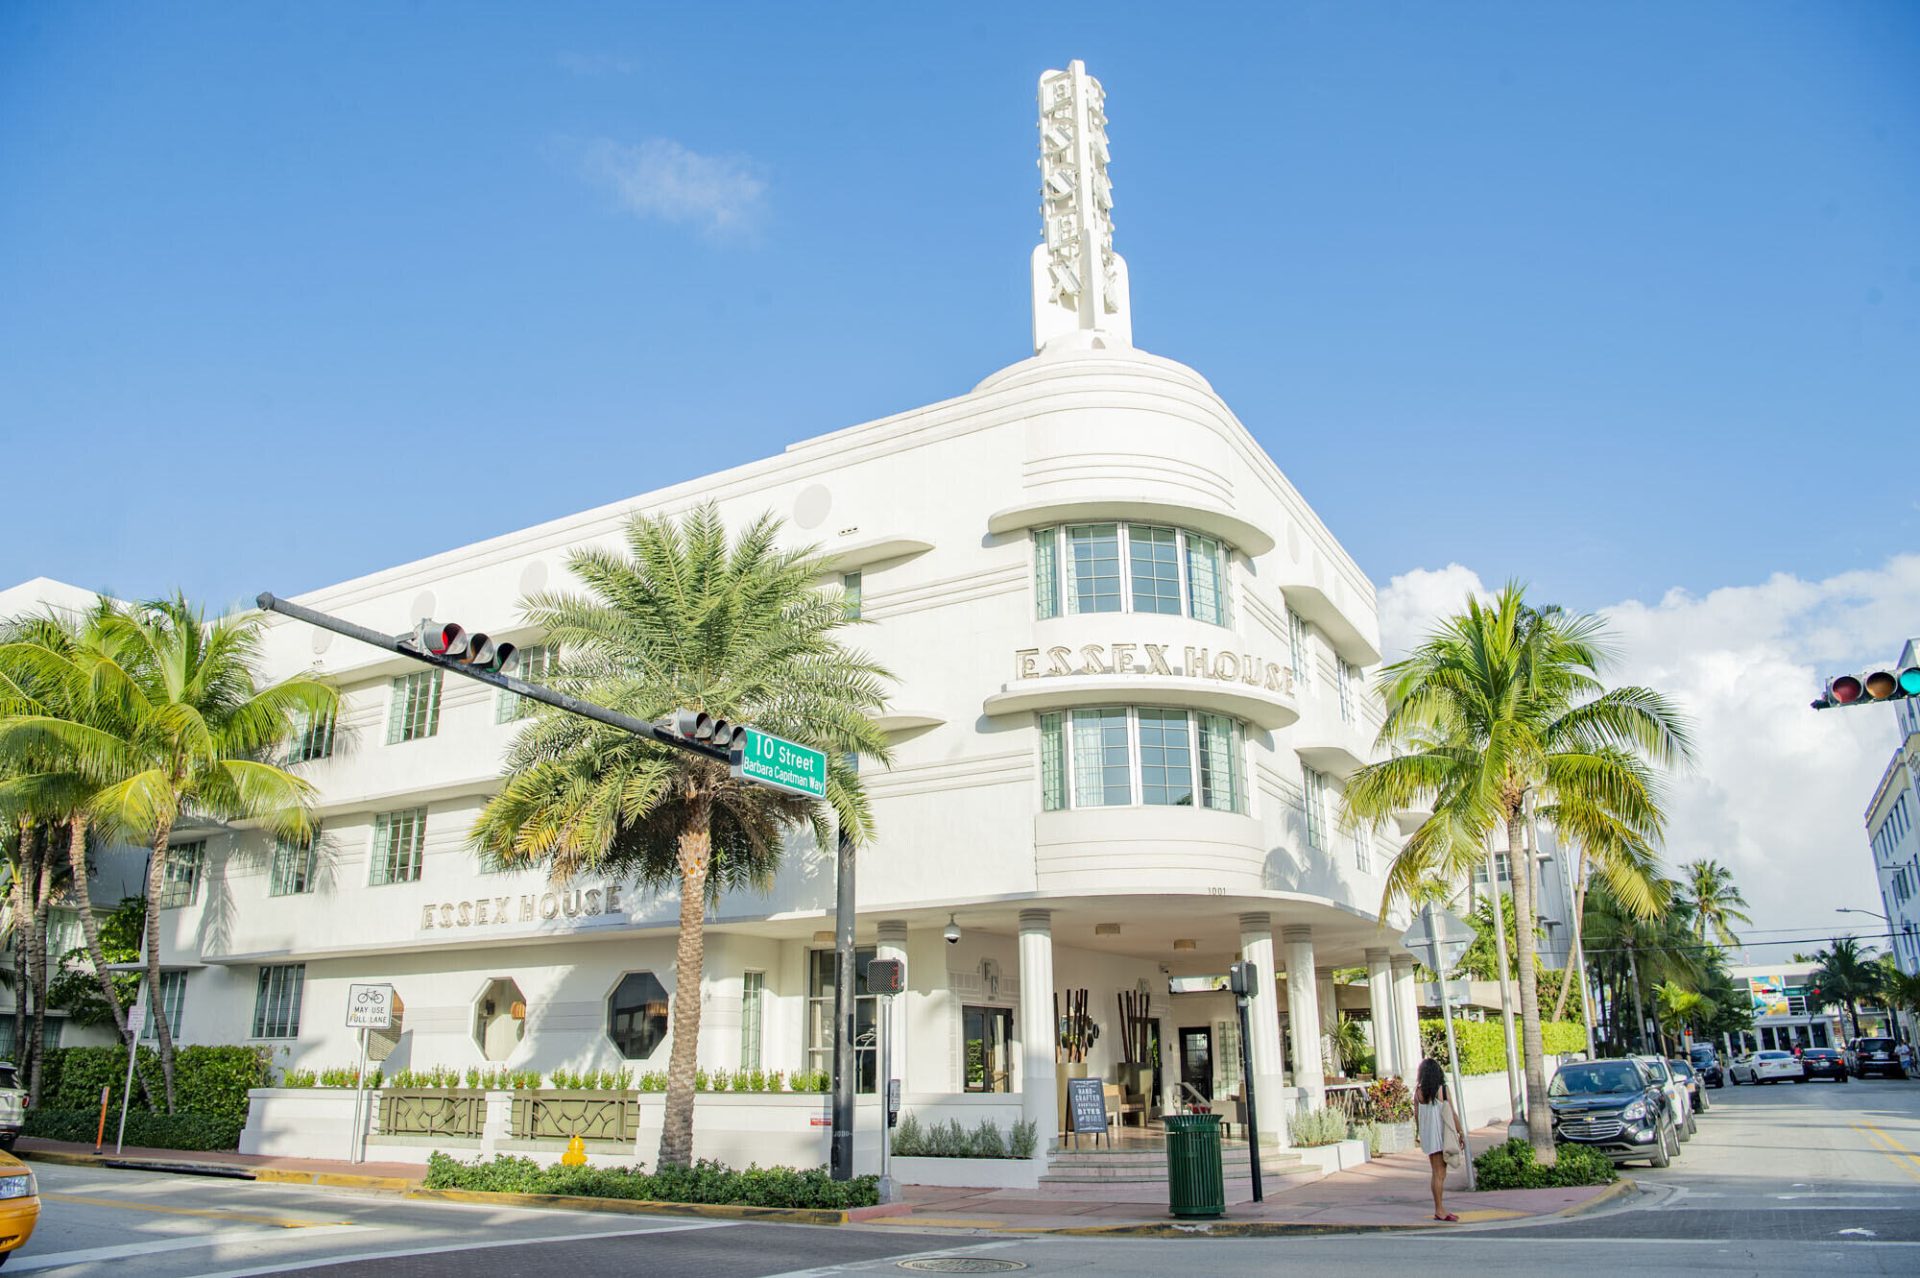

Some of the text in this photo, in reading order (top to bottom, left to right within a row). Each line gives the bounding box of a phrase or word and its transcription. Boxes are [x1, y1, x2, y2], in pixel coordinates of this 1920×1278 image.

[1015, 643, 1296, 699] ESSEX HOUSE
[756, 734, 814, 773] 10 Street
[743, 756, 824, 794] Barbara Capitman Way
[421, 885, 624, 931] ESSEX HOUSE
[370, 1016, 387, 1024] LANE
[371, 1006, 385, 1014] USE
